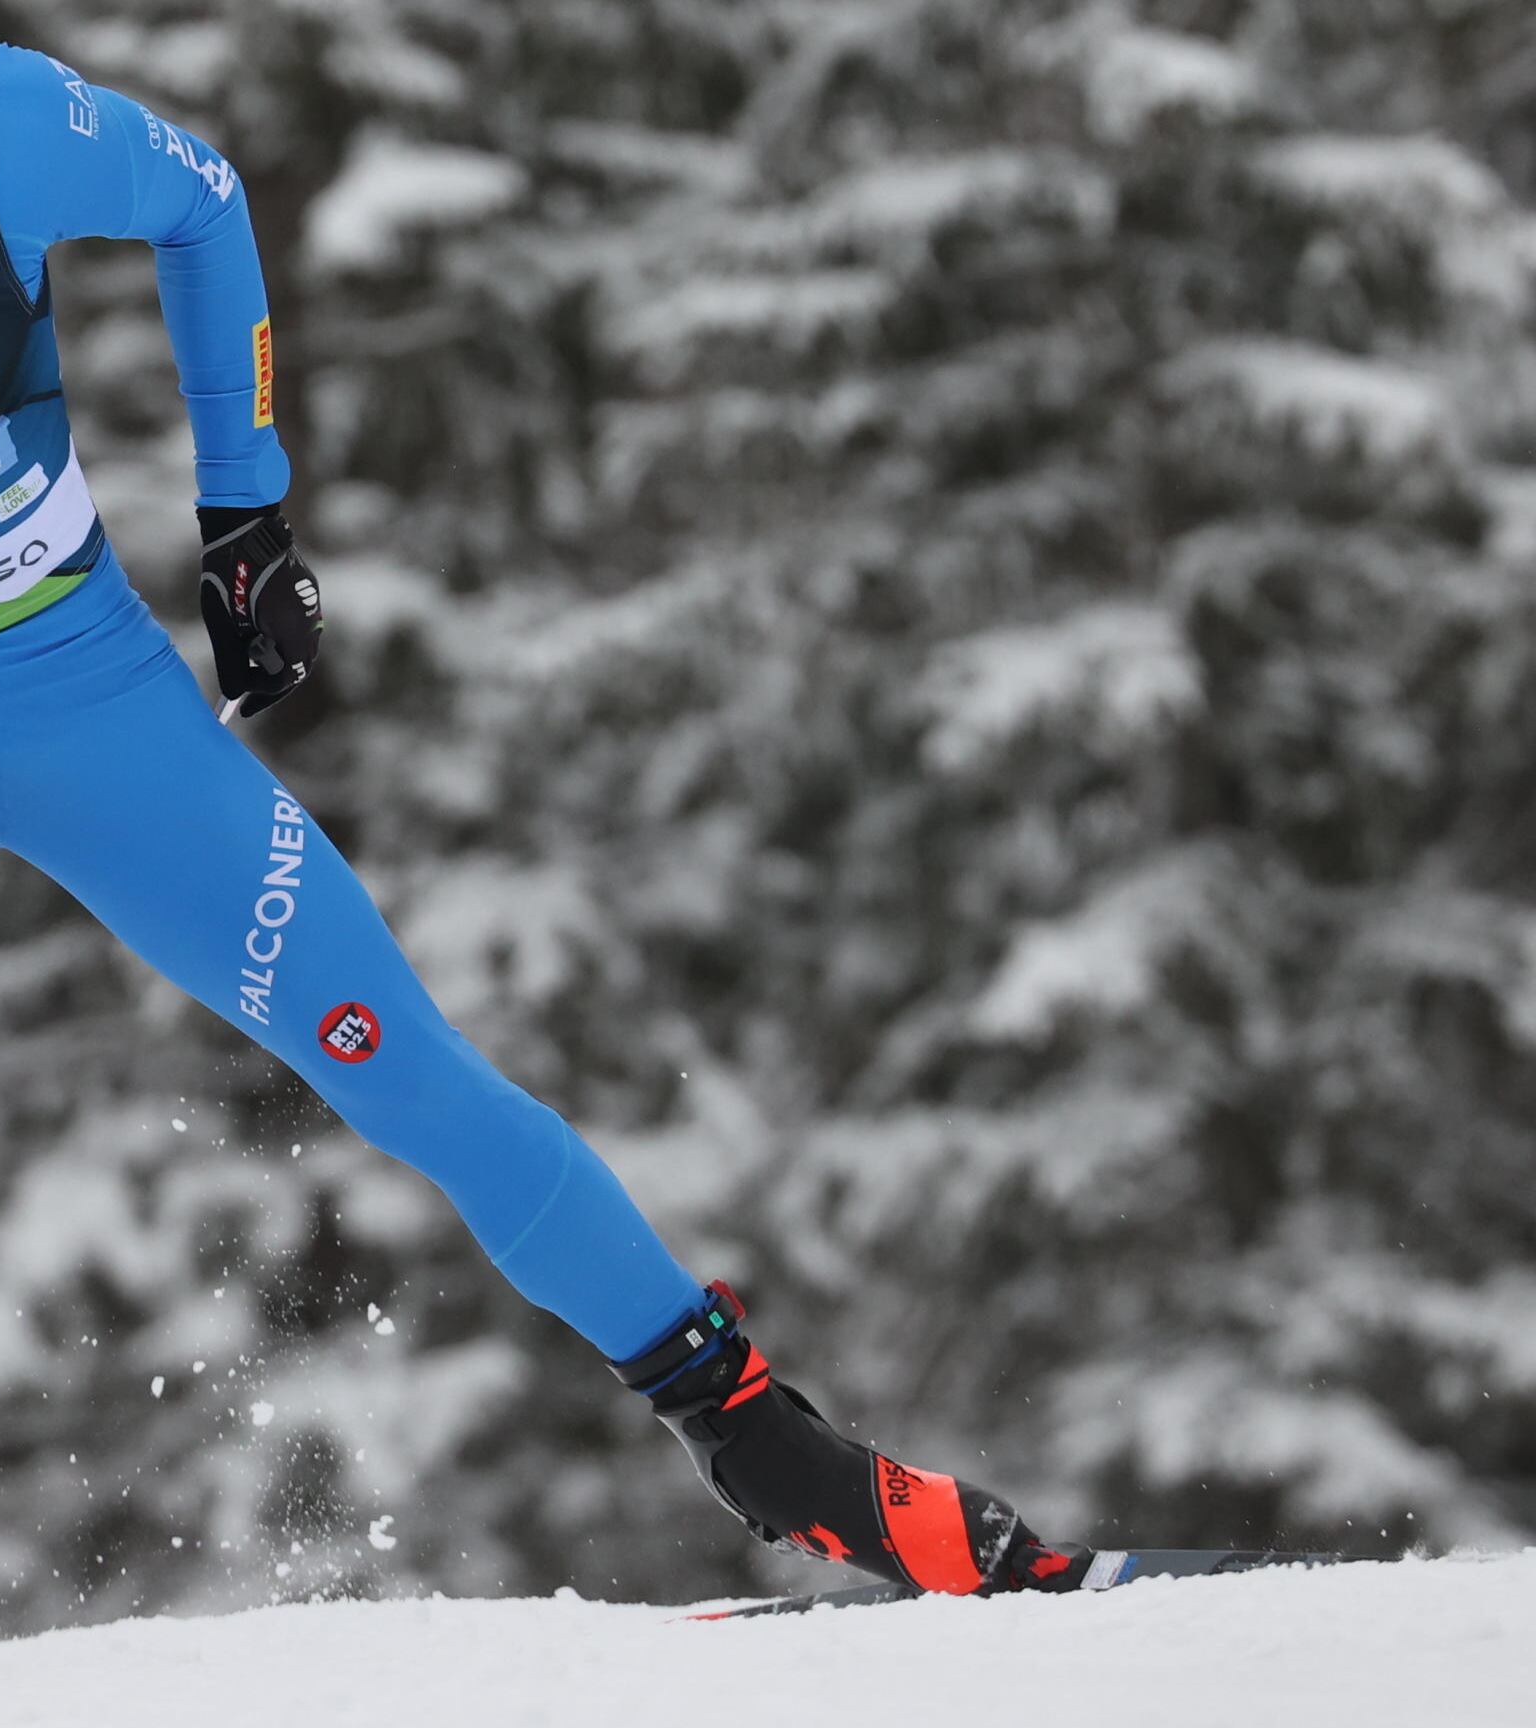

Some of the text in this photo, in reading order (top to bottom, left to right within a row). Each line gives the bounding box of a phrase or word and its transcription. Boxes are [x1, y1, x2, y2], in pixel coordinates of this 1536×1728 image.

[1, 484, 23, 503] FEEL
[326, 1013, 363, 1050] RTL
[340, 1019, 372, 1056] 102.5
